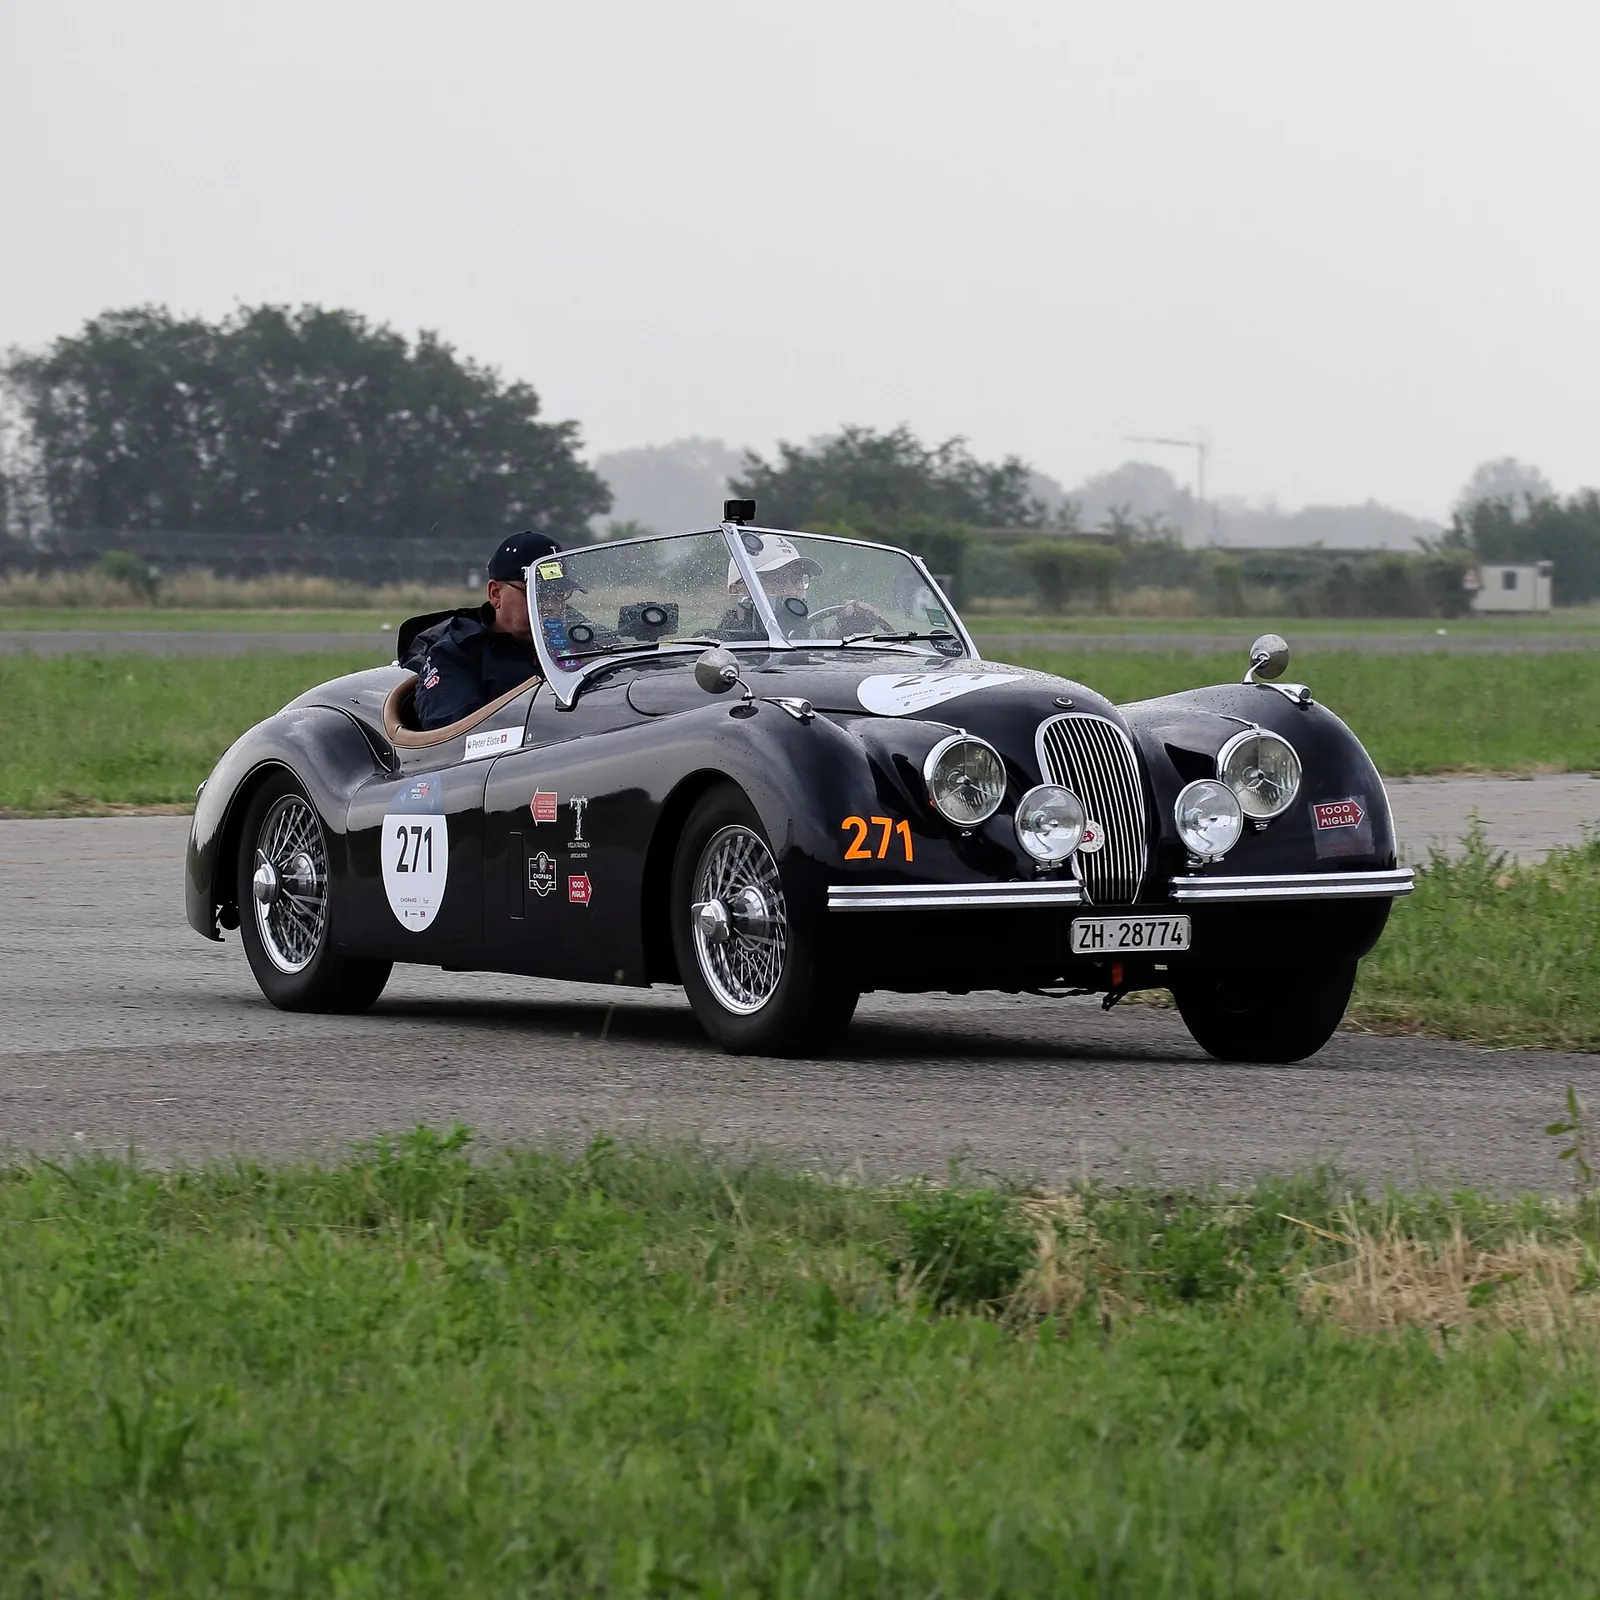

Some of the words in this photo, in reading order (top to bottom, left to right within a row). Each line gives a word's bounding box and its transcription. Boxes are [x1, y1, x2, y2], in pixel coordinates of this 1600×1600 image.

[472, 739, 486, 749] Peter
[1320, 805, 1350, 815] 1000
[1321, 815, 1355, 826] MIGLIA
[841, 816, 913, 862] 271
[396, 825, 433, 873] 271
